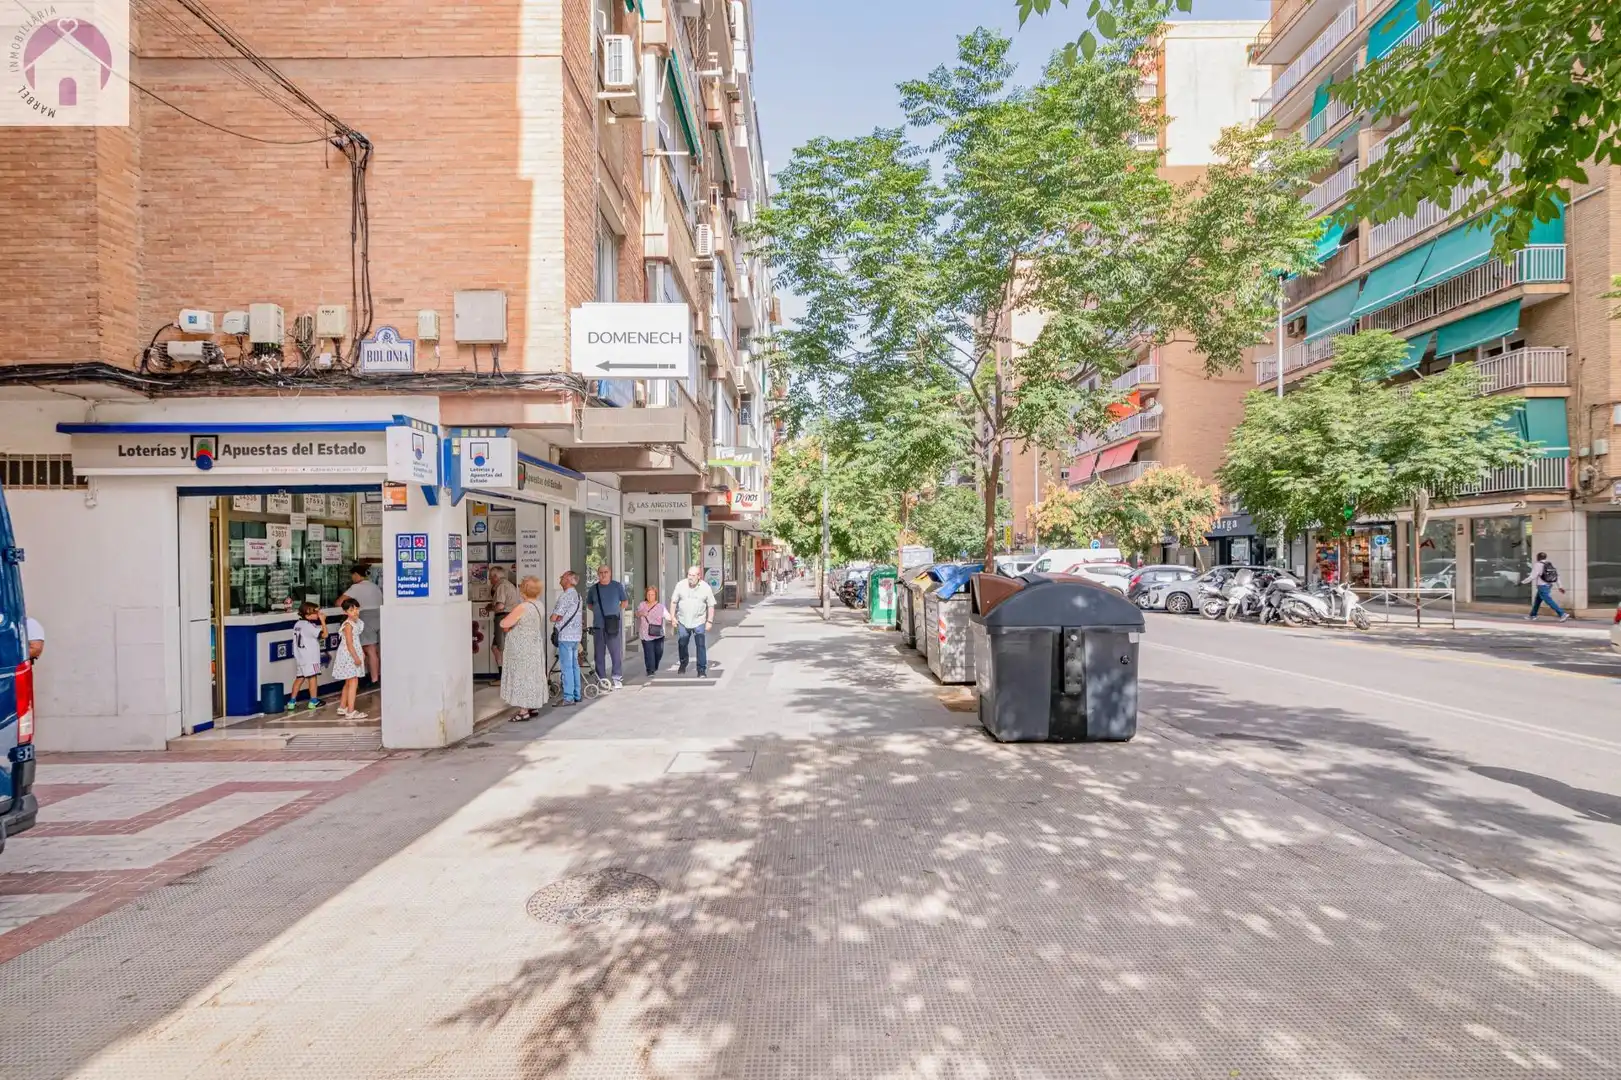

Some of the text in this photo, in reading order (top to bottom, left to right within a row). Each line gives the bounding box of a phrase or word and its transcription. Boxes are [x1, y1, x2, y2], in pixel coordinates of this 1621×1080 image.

[587, 331, 682, 344] DOMENECH
[366, 349, 409, 363] BOLONIA
[118, 442, 366, 459] Loterías y Apuestas del Estado
[636, 501, 688, 509] LAS ANGUSTIAS
